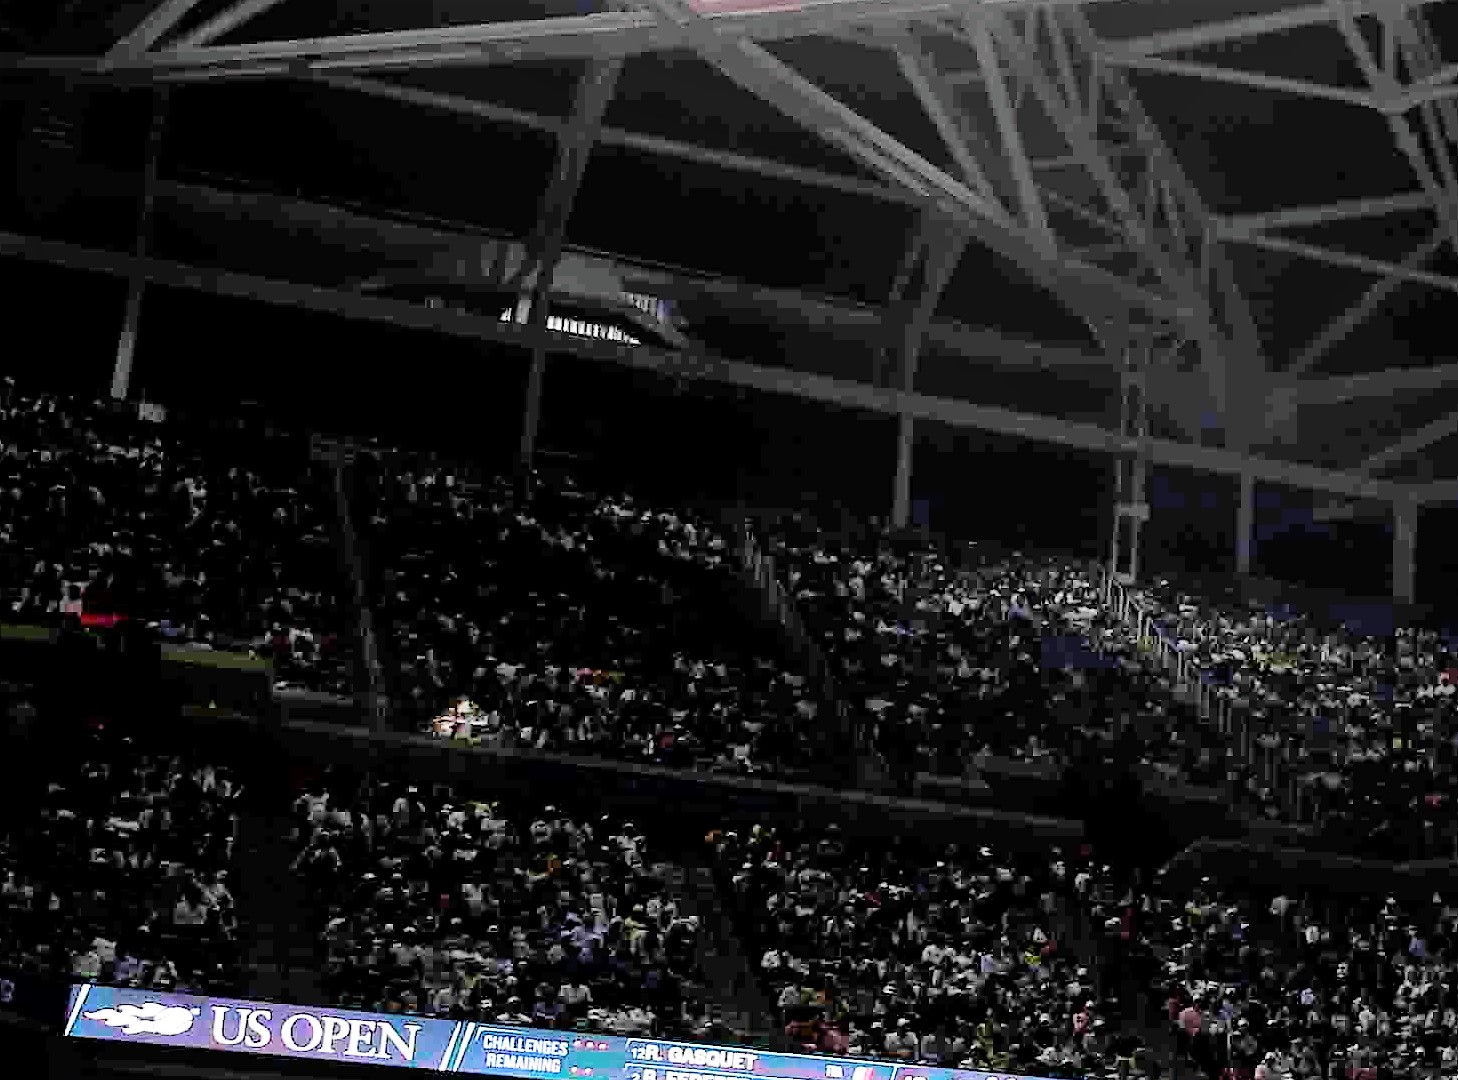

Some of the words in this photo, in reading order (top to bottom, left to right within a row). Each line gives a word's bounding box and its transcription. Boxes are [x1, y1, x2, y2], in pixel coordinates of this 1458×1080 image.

[210, 1005, 271, 1049] US
[280, 1010, 421, 1063] OPEN
[482, 1034, 570, 1057] CHALLENGES
[486, 1052, 562, 1074] REMAINING
[667, 1046, 758, 1071] GASQUET
